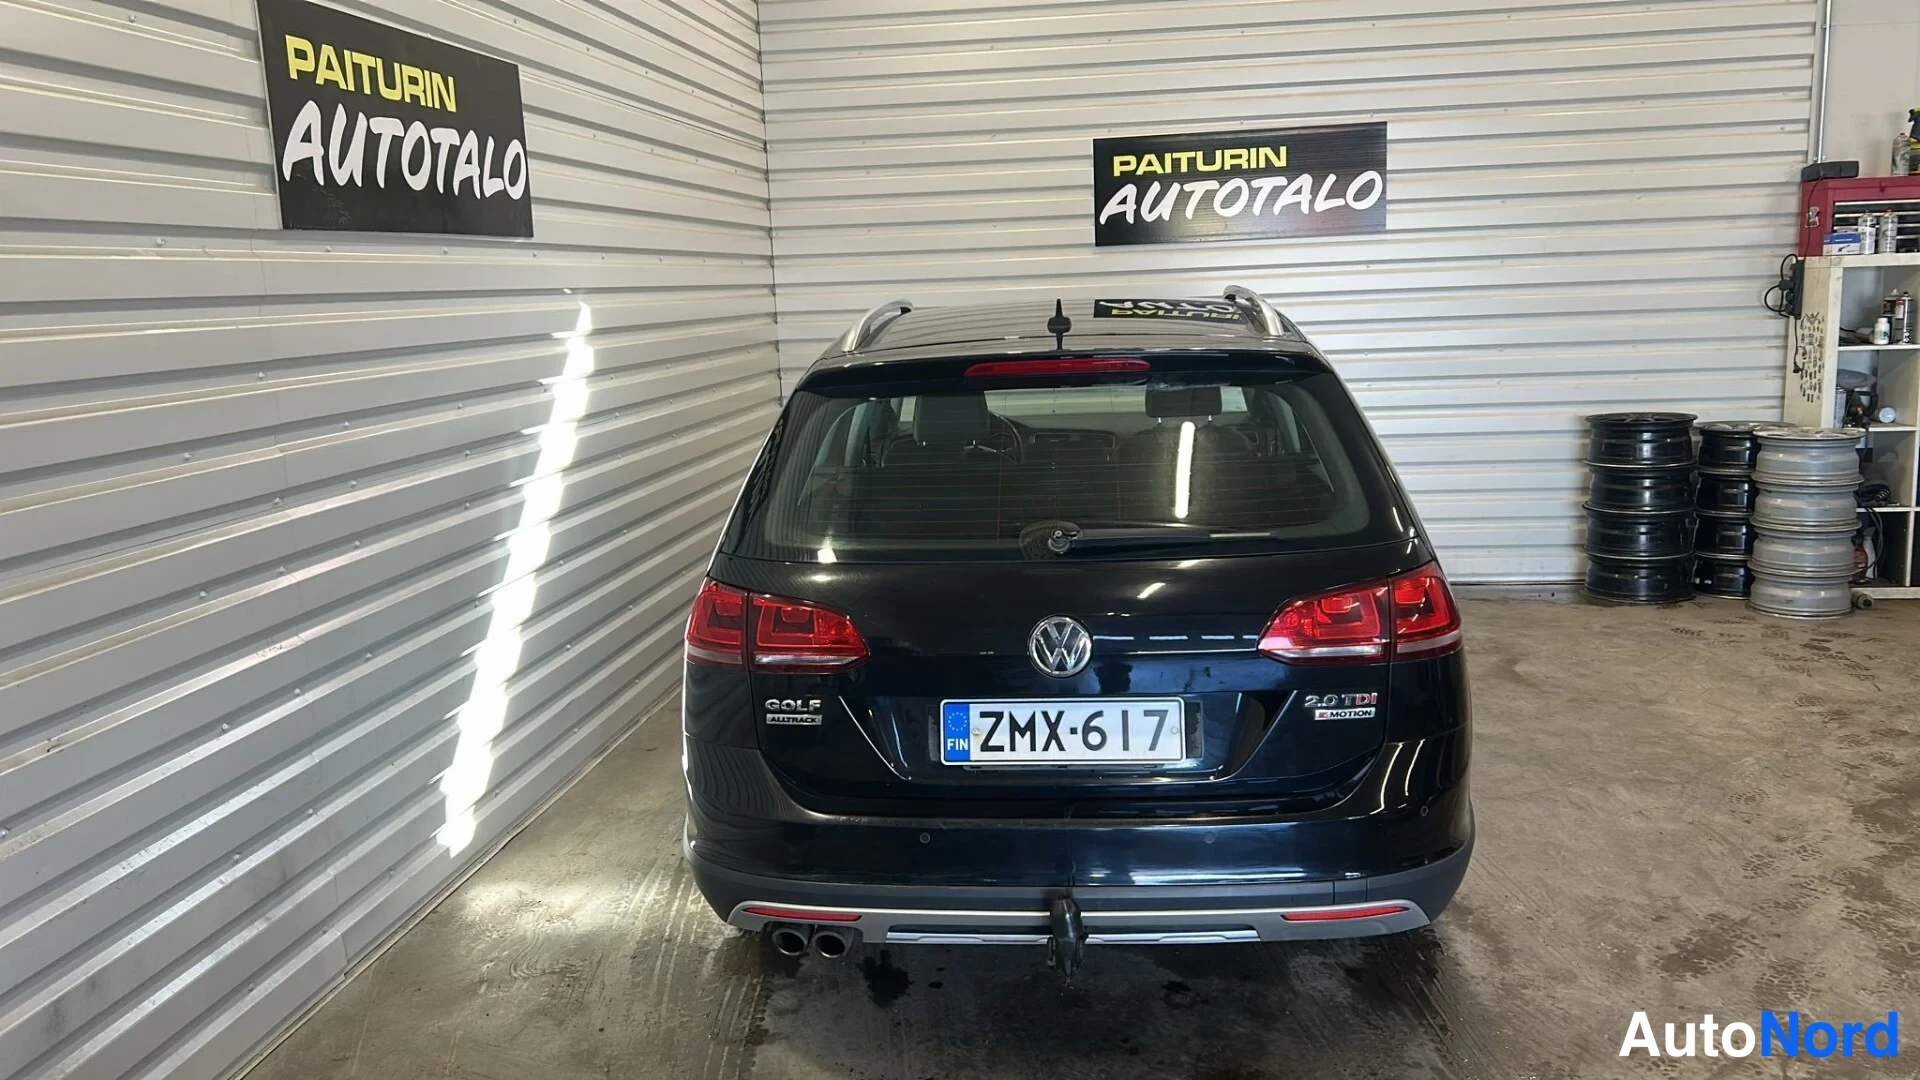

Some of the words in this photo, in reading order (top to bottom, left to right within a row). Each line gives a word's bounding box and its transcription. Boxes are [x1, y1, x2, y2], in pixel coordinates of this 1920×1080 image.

[285, 34, 457, 113] PAITURIN
[282, 100, 527, 200] AUTOTALO
[1112, 145, 1287, 177] PAITURIN
[1099, 170, 1384, 225] AUTOTALO
[1029, 615, 1092, 678] VW
[764, 698, 822, 712] GOLF
[1304, 694, 1338, 708] 2.0
[1341, 692, 1378, 706] TDI
[770, 715, 818, 724] ALLTRACK
[979, 709, 1169, 752] ZMX-617
[947, 737, 968, 751] FIN
